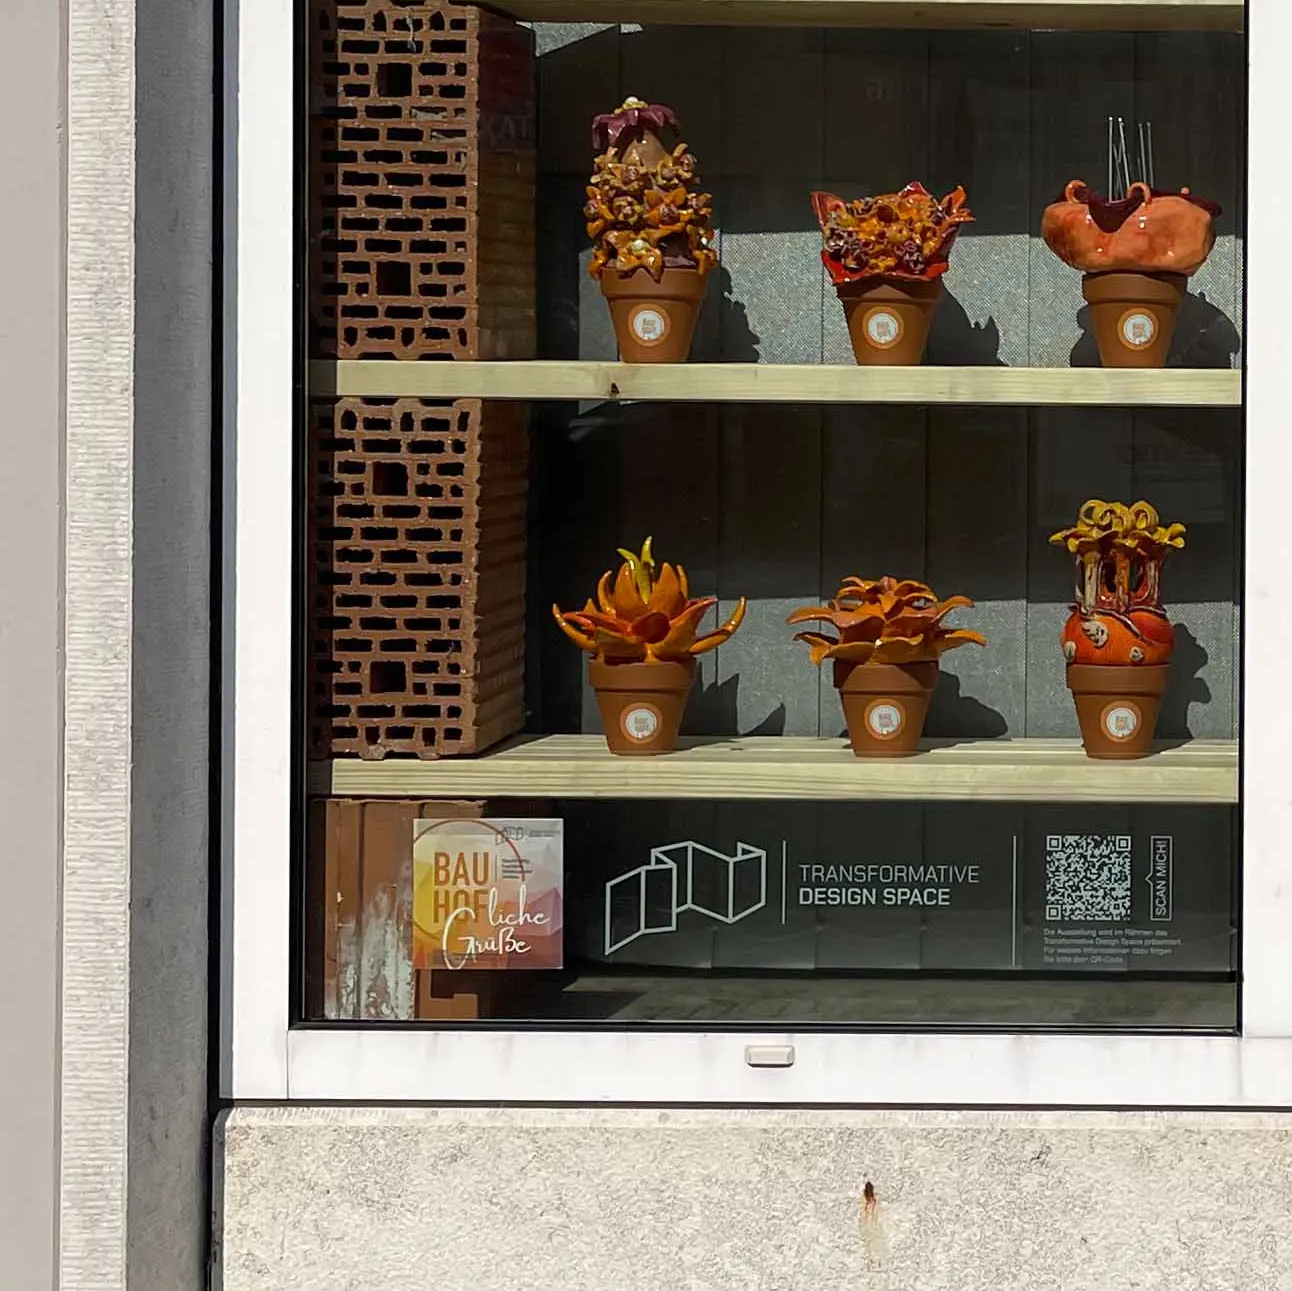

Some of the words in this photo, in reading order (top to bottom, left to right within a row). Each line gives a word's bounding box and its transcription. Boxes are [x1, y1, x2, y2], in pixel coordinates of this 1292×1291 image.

[433, 851, 489, 886] BAU
[799, 864, 980, 884] TRANSFORMATIVE
[799, 887, 877, 906] DESIGN
[883, 887, 951, 906] SPACE
[1155, 880, 1167, 916] SCAN
